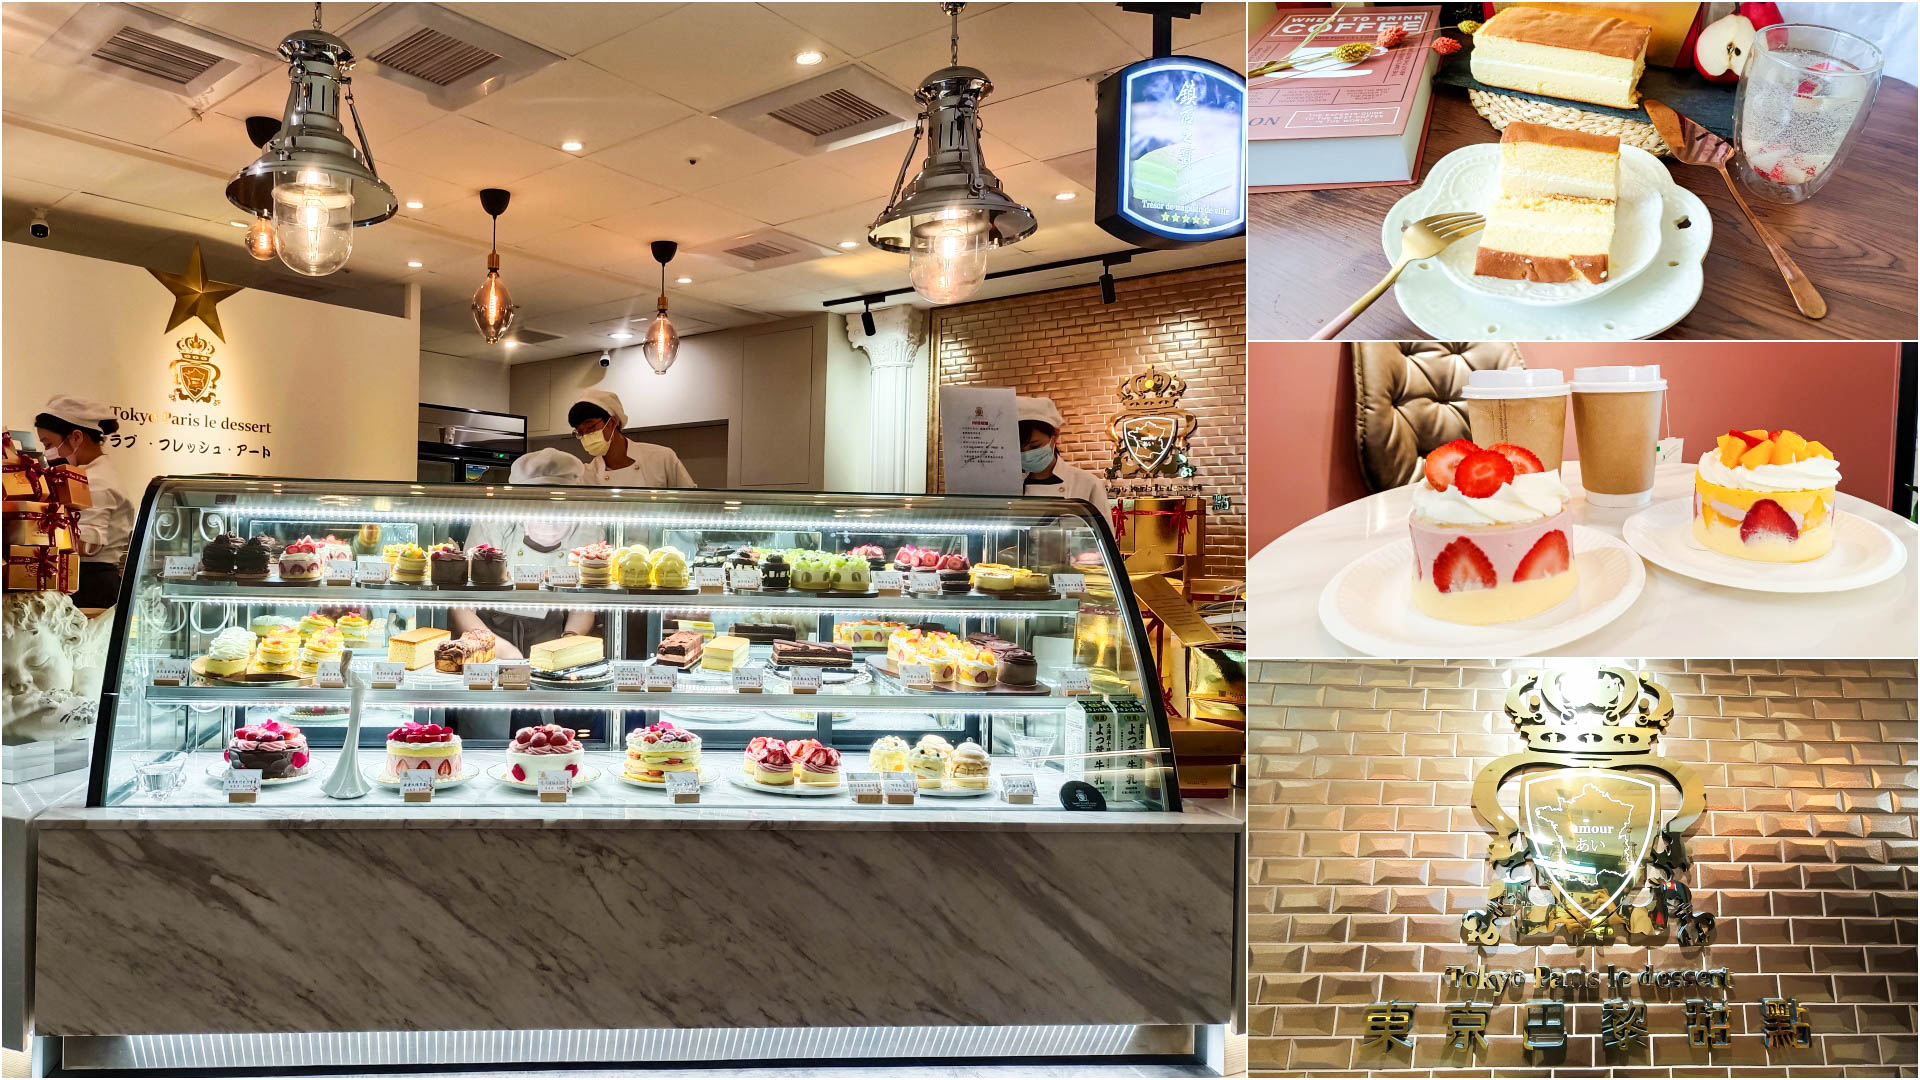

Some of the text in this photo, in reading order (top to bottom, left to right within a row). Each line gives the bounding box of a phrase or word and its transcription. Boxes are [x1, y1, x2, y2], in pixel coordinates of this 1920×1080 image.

[1282, 21, 1421, 34] COFFEE
[110, 406, 272, 434] Tokyo Paris le dessert
[1569, 825, 1614, 834] amour
[1575, 837, 1606, 853] あい
[1445, 962, 1735, 996] Tokyo Paris le dessert
[1360, 999, 1813, 1054] 東京巴黎甜點
